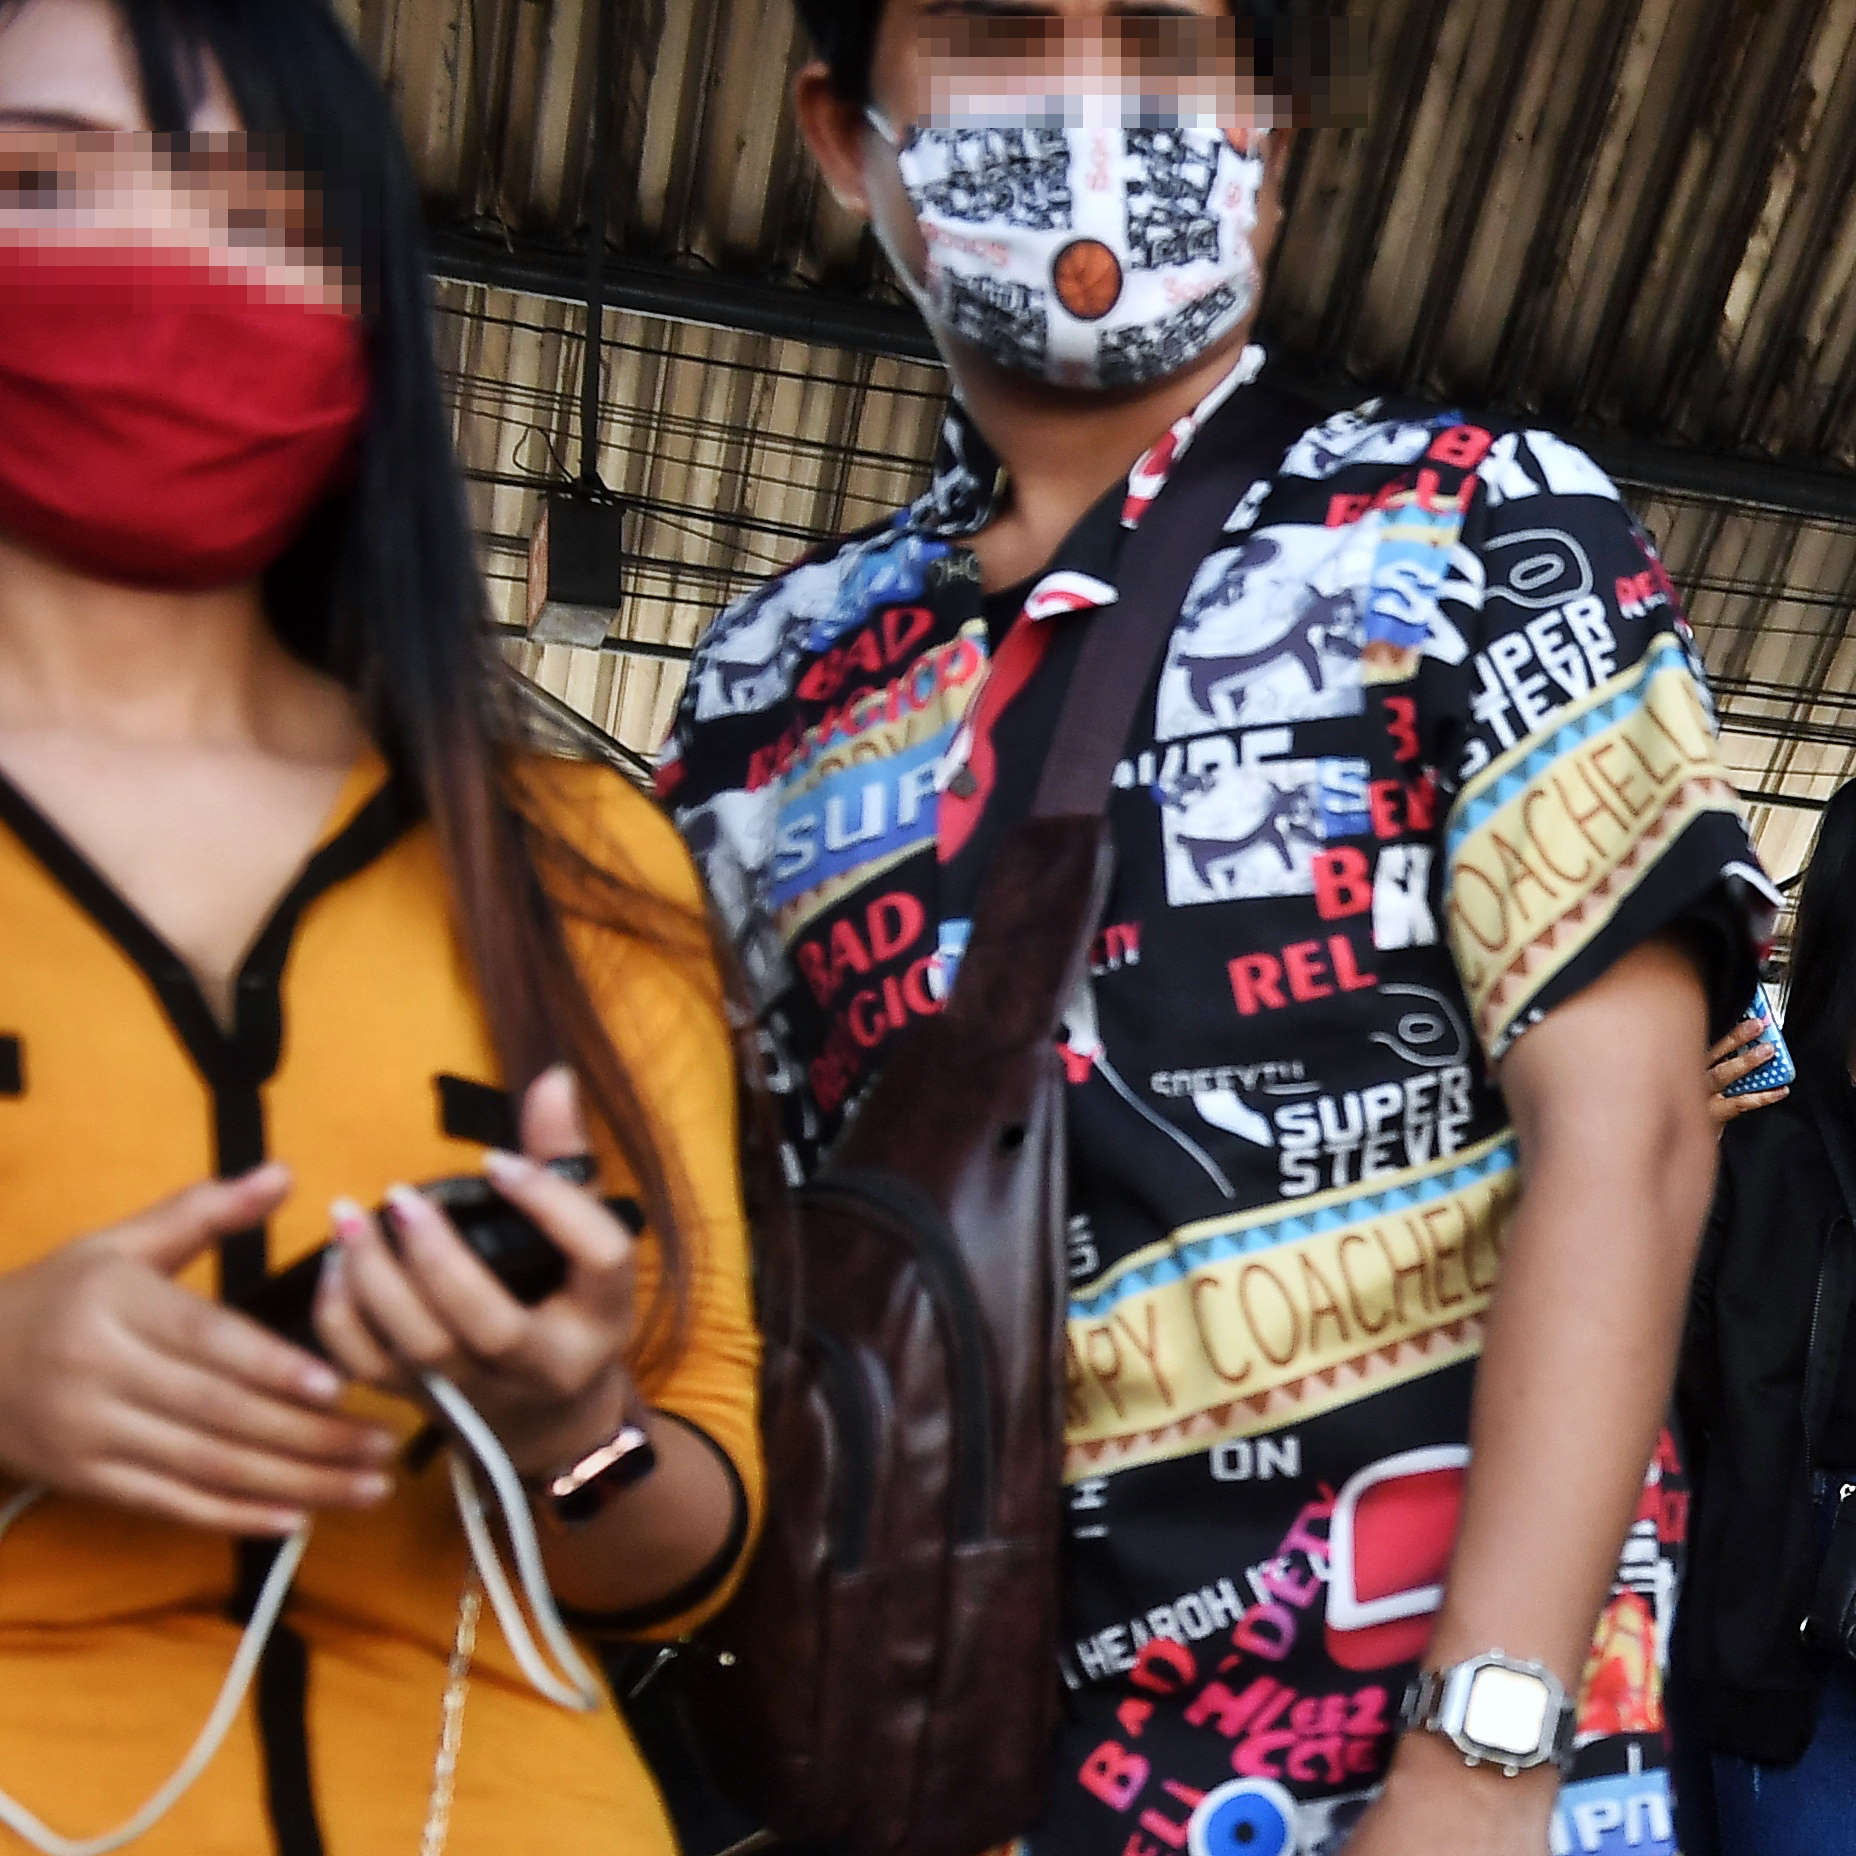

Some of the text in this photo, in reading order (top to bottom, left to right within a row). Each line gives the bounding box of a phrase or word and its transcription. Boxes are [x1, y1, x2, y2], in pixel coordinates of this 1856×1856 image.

[1274, 1065, 1472, 1148] SUPER
[1278, 1115, 1471, 1198] STEVE
[1208, 1438, 1300, 1483] ON
